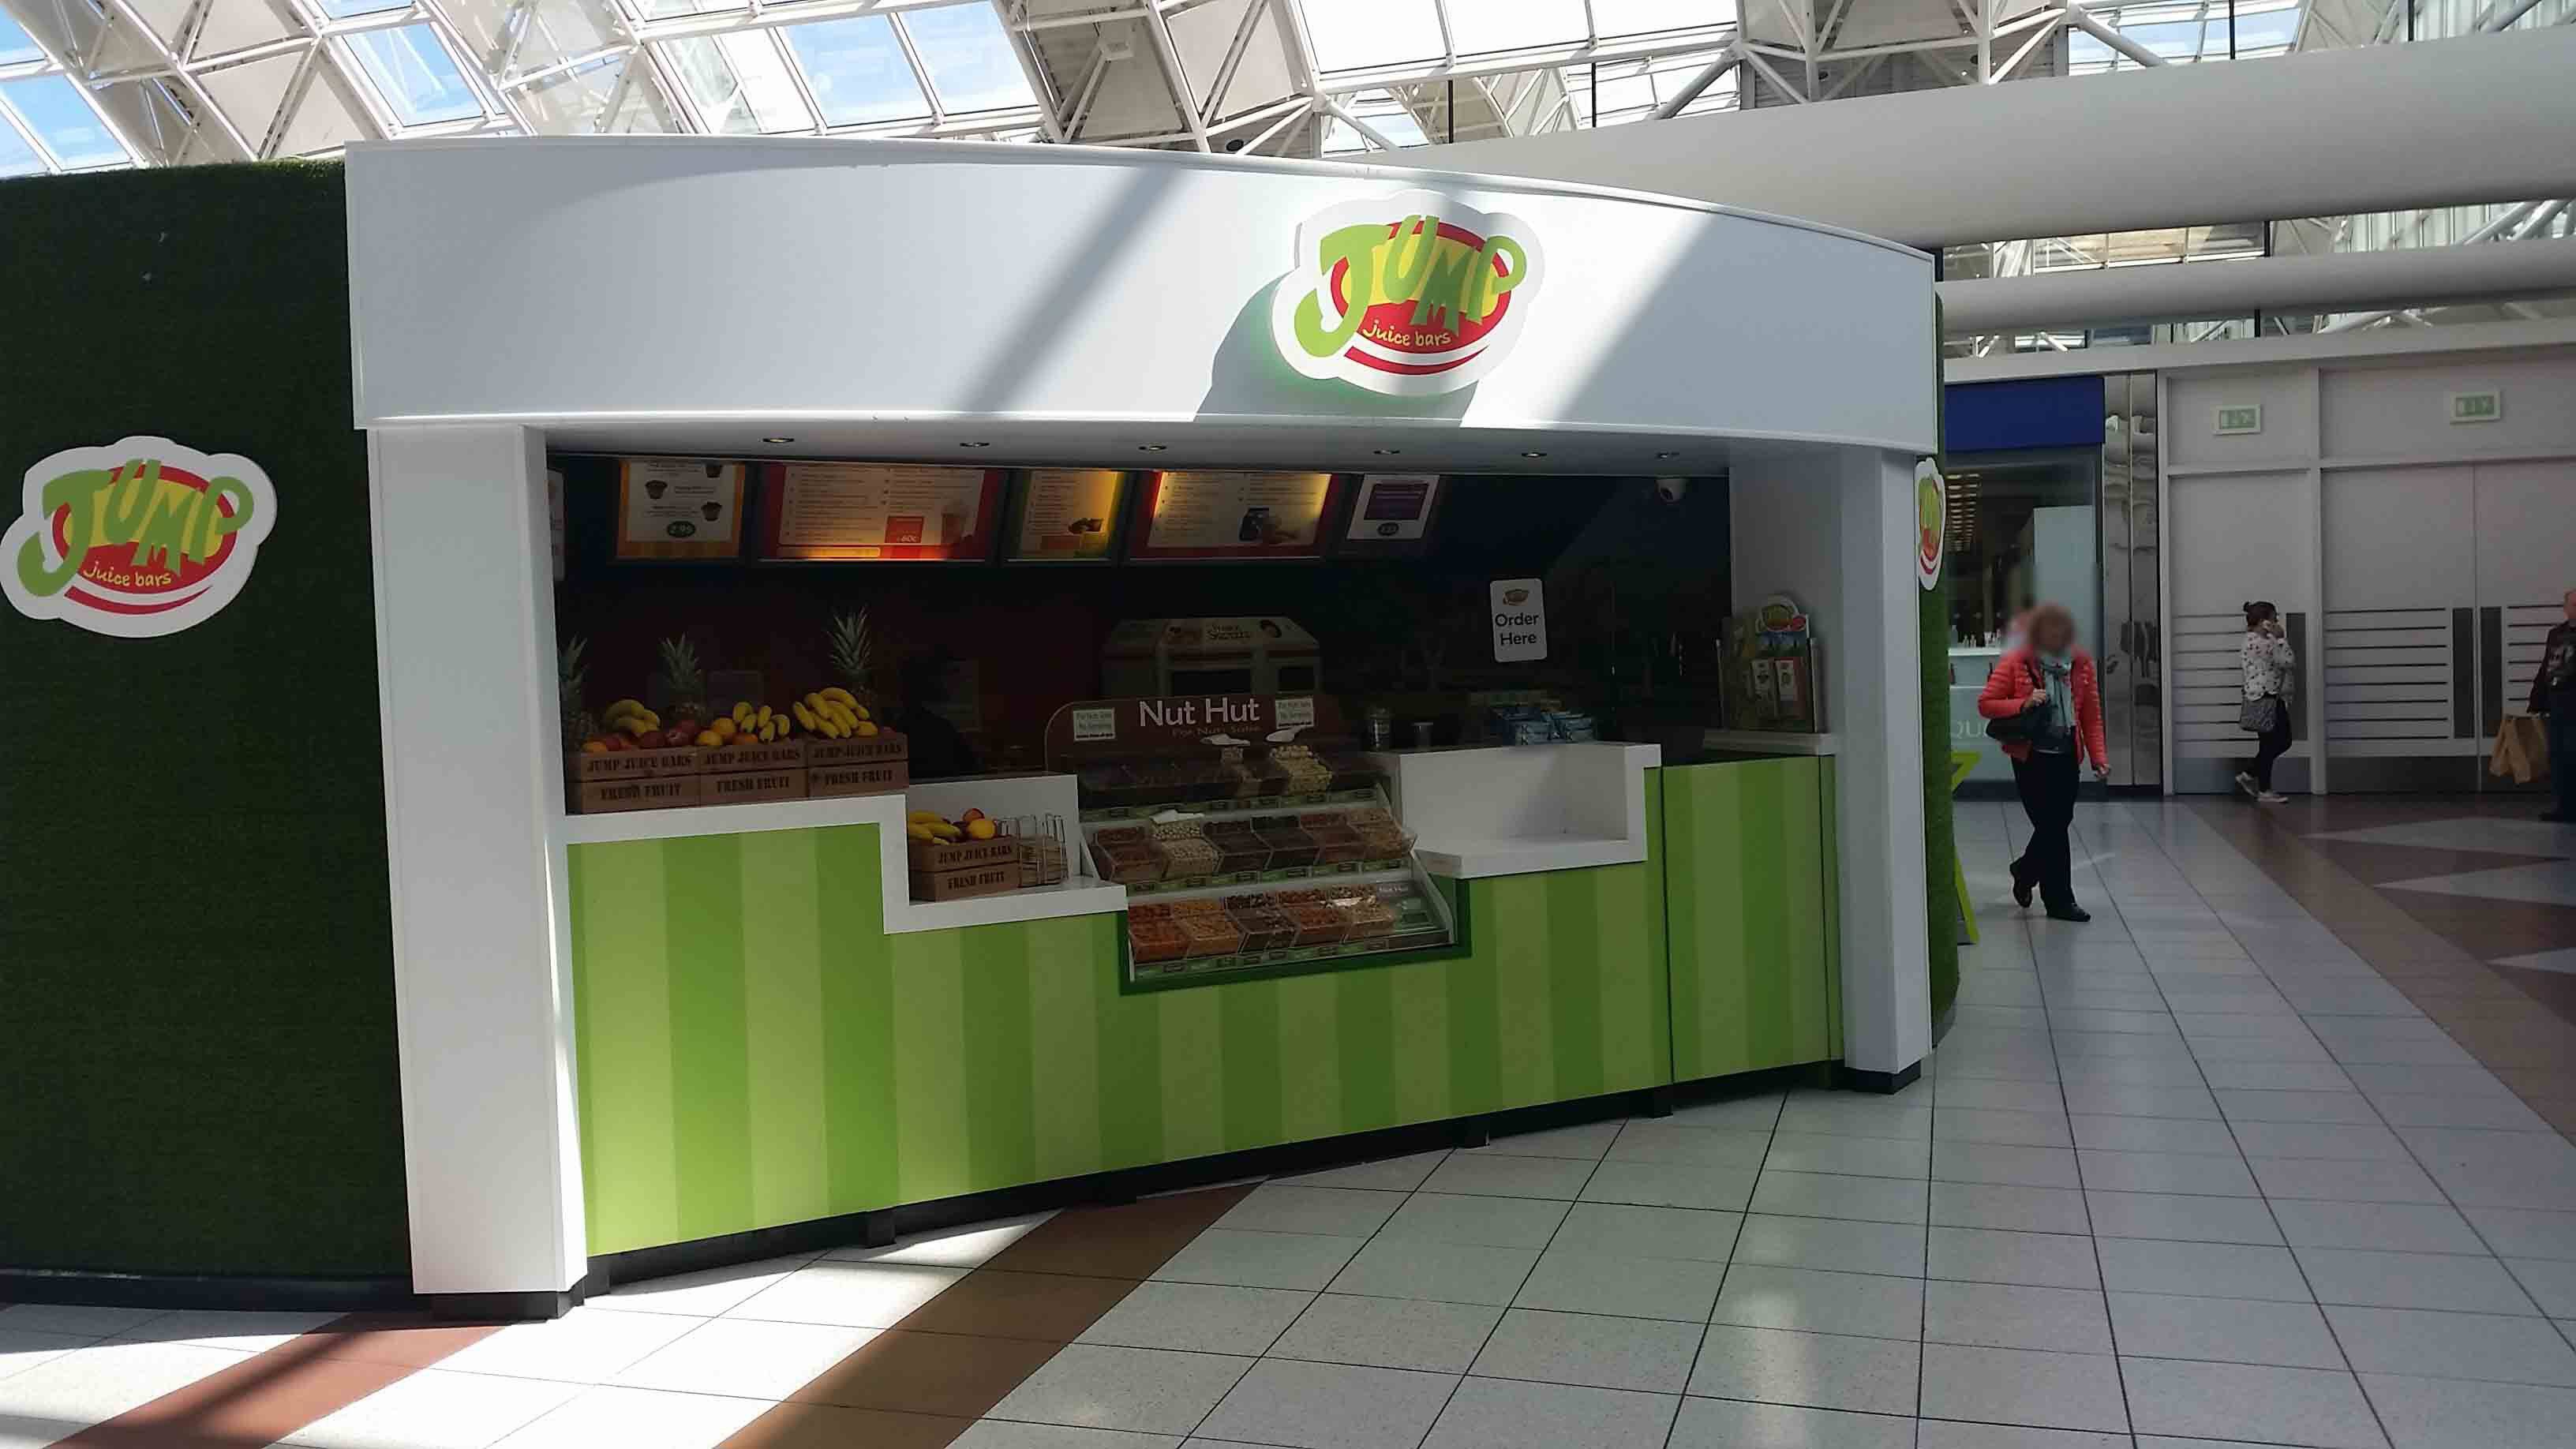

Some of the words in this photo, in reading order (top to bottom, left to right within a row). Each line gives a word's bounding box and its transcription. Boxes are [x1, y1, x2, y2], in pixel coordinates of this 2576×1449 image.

[1294, 214, 1527, 358] JUMP
[1363, 320, 1411, 346] juice
[1414, 331, 1452, 346] bars
[17, 458, 254, 597] JUMP
[83, 561, 130, 586] juice
[135, 571, 171, 586] bars
[1495, 612, 1540, 627] Order
[1500, 632, 1537, 646] Here
[1139, 699, 1197, 727] Nut
[1205, 697, 1261, 724] Hut
